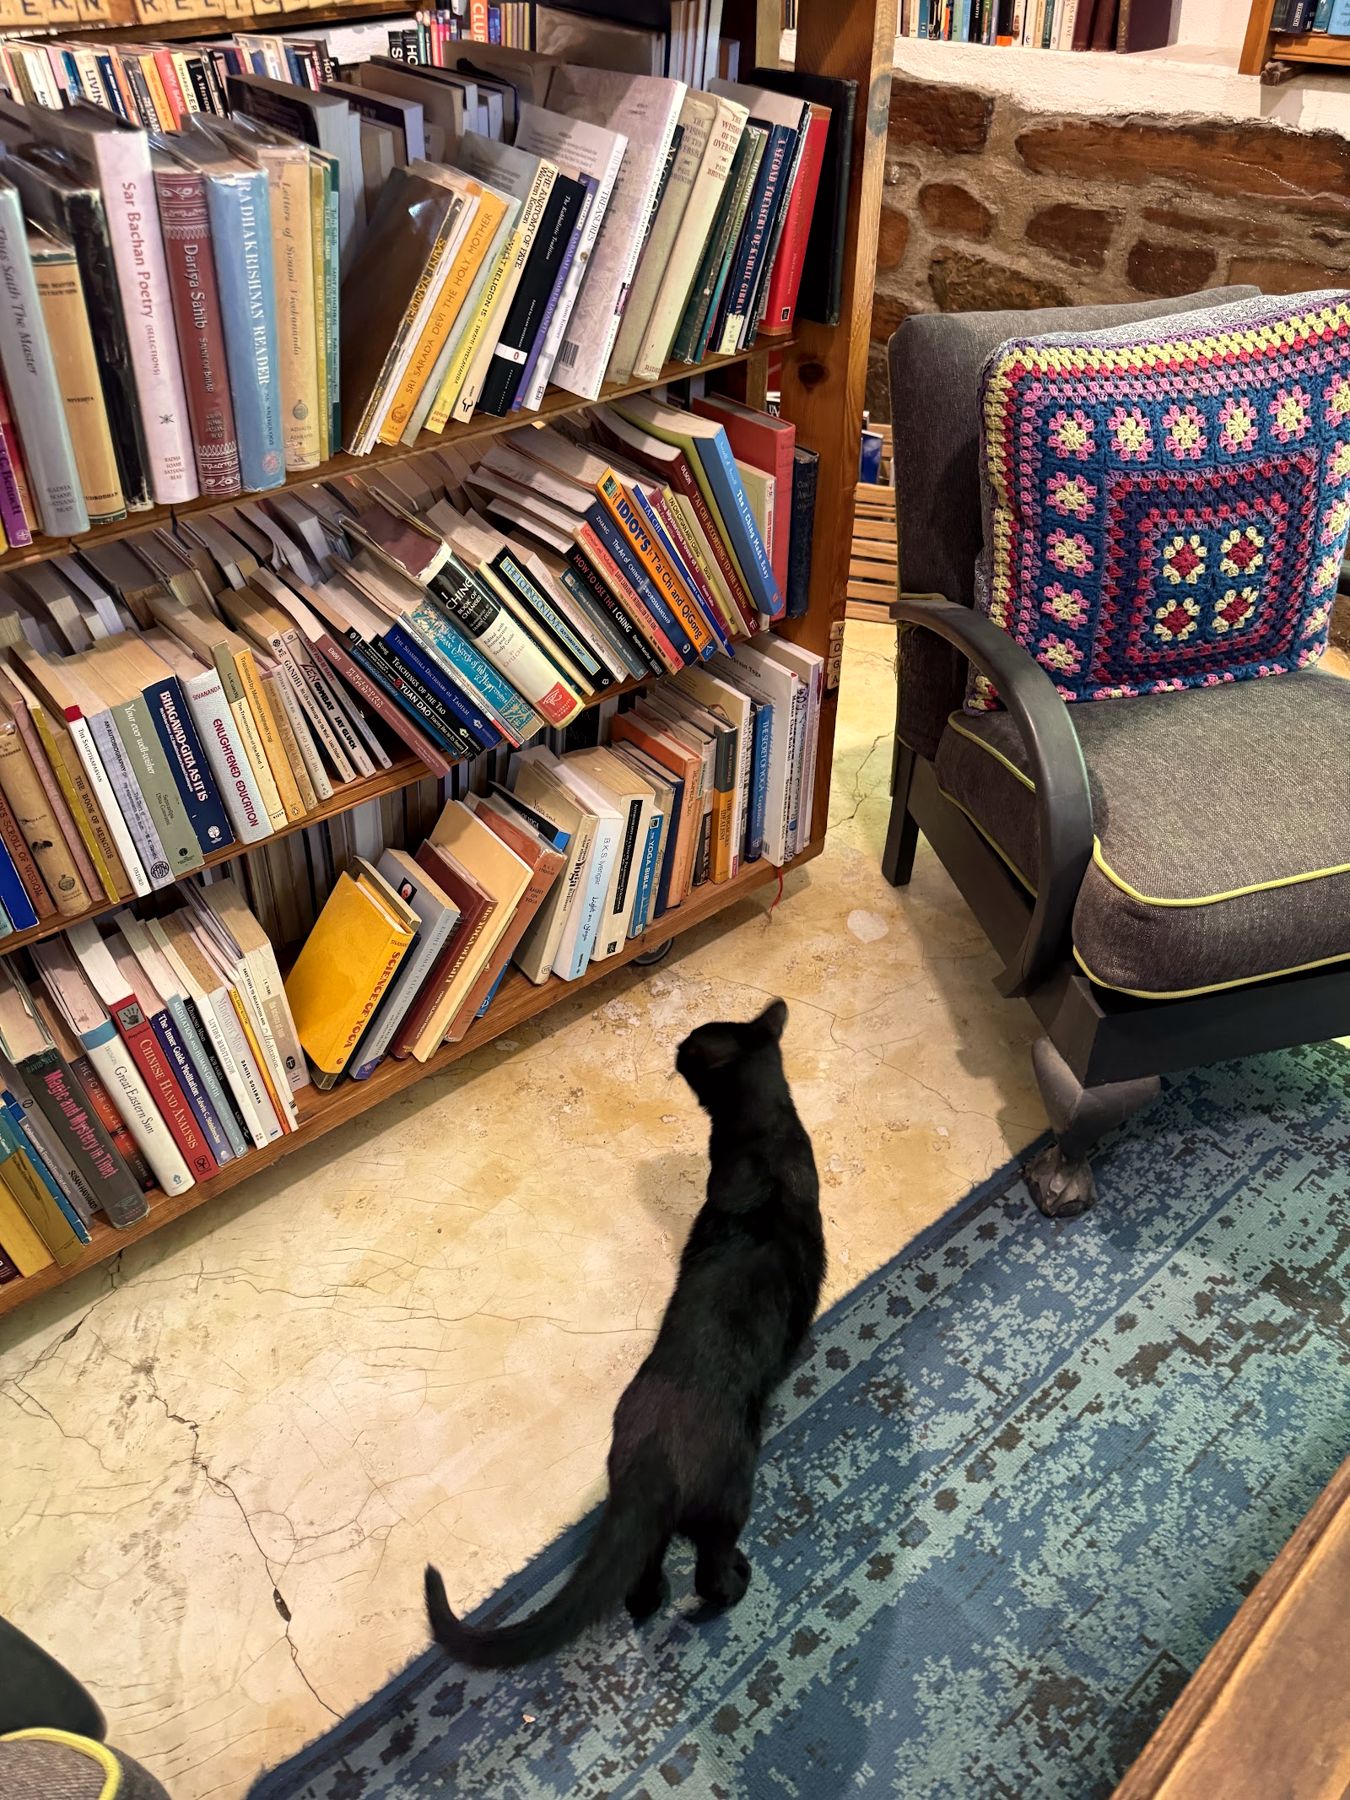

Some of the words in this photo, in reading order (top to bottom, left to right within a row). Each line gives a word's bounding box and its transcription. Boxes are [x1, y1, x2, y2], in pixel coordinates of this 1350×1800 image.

[541, 168, 556, 189] THE
[767, 146, 784, 183] SECOND
[121, 180, 140, 208] Sar
[529, 165, 548, 196] Warren
[280, 182, 294, 223] Letters
[519, 196, 537, 225] Kenton
[525, 188, 549, 235] ANATOMY
[562, 195, 571, 206] The
[754, 185, 774, 231] TREASURY
[283, 227, 295, 239] of
[552, 205, 568, 236] Kabbalistic
[126, 210, 148, 267] Bachan
[497, 237, 515, 266] WHAT
[521, 233, 533, 247] OF
[544, 236, 558, 262] Tradition
[560, 230, 579, 270] QABALAH
[750, 233, 761, 245] OF
[180, 244, 203, 288] Dariya
[285, 246, 298, 283] Swami
[426, 237, 448, 272] SAINT
[512, 246, 528, 271] FATE
[741, 247, 758, 281] KAHLIL
[134, 270, 156, 319] Poetry
[236, 180, 265, 320] RADHAKRISHNAN
[252, 326, 271, 385] READER
[482, 266, 504, 308] RELIGION
[549, 274, 564, 303] AMBER
[189, 291, 209, 330] Sahib
[403, 274, 434, 327] NAMDEV
[404, 377, 418, 394] SRI
[411, 337, 436, 377] SARADA
[429, 310, 448, 336] DEVI
[441, 287, 458, 310] THE
[451, 256, 472, 287] HOLY
[465, 211, 493, 256] MOTHER
[479, 307, 489, 318] IS
[733, 282, 748, 315] GIBRAN
[288, 289, 302, 356] Vivekananda
[538, 303, 555, 334] JAYANTI
[467, 323, 481, 346] SWAMI
[594, 514, 611, 536] ZHANG
[611, 496, 654, 554] IDIOT'S
[734, 489, 748, 509] The
[742, 514, 758, 539] Ching
[751, 539, 765, 560] Made
[758, 561, 771, 580] Easy
[610, 537, 623, 552] The
[617, 548, 629, 560] Art
[622, 556, 632, 565] of
[626, 562, 645, 586] CHINESE
[648, 554, 667, 575] T'ai
[443, 577, 476, 611] CHING
[572, 553, 591, 574] HOW
[585, 571, 599, 585] TO
[592, 580, 607, 597] USE
[601, 593, 616, 609] THE
[613, 610, 634, 634] CHING
[658, 571, 676, 592] Chi
[455, 598, 472, 616] BOOK
[467, 588, 479, 600] OF
[459, 594, 484, 620] CHANGES
[640, 583, 672, 626] SWORDSMANSHIP
[669, 588, 685, 607] and
[676, 603, 706, 640] QiGong
[282, 657, 305, 688] GANDHI
[390, 655, 421, 688] TEACHINGS
[417, 684, 428, 696] OF
[424, 692, 438, 706] THE
[433, 700, 448, 716] TAO
[393, 634, 405, 647] THE
[402, 643, 428, 670] SHAMBHALA
[423, 667, 448, 693] DICTIONARY
[445, 689, 453, 698] OF
[450, 694, 471, 716] TAOISM
[191, 684, 222, 701] SIVANANDA
[299, 687, 307, 695] His
[299, 658, 323, 686] ZEN
[312, 680, 335, 712] COMBAT
[333, 715, 345, 729] JAY
[339, 726, 358, 751] GLUCK
[302, 693, 311, 702] Life
[306, 699, 314, 707] and
[102, 719, 111, 729] AN
[308, 705, 321, 721] Message
[315, 717, 324, 726] for
[741, 717, 750, 736] YOGA
[761, 719, 769, 734] THE
[158, 690, 197, 769] BHAGAVAD-GITA
[321, 728, 332, 740] World
[740, 736, 749, 750] FOR
[106, 728, 127, 773] AUTOBIOGRAPHY
[759, 733, 769, 760] SECRET
[187, 766, 201, 782] AS
[210, 717, 243, 779] ENLIGHTENED
[233, 778, 260, 828] EDUCATION
[737, 751, 748, 789] PREGNANCY
[759, 759, 767, 770] OF
[73, 775, 86, 792] THE
[192, 779, 205, 792] IT
[757, 769, 766, 792] YOGA
[81, 793, 96, 815] BOOK
[196, 789, 209, 802] IS
[90, 814, 100, 826] OF
[718, 808, 728, 841] IDEALISM
[94, 825, 115, 861] MENCIUS
[644, 839, 656, 867] YOGA
[565, 855, 586, 889] Yoga
[640, 866, 651, 890] BIBLE
[586, 895, 599, 914] Light
[586, 913, 592, 922] on
[430, 924, 447, 948] EIGHT
[579, 922, 591, 942] Yoga
[417, 947, 435, 975] HUMAN
[367, 949, 402, 1003] SCIENCE
[400, 974, 420, 1005] TALENTS
[359, 999, 374, 1018] OF
[206, 1016, 222, 1040] LIVING
[214, 1038, 236, 1076] MEDITATION
[342, 1016, 366, 1052] YOGA
[171, 1000, 196, 1040] MEDITATION
[188, 1039, 199, 1052] AND
[194, 1048, 211, 1073] HUMAN
[203, 1070, 222, 1098] GROWTH
[40, 1067, 73, 1103] Magic
[137, 1036, 169, 1081] CHINESE
[157, 1078, 182, 1109] HAND
[171, 1105, 202, 1150] ANALYSIS
[156, 1013, 170, 1029] The
[163, 1027, 178, 1047] Inner
[171, 1044, 187, 1065] Guide
[179, 1063, 202, 1097] Meditation
[194, 1095, 209, 1114] Edwin
[204, 1116, 223, 1145] Steinbrecher
[239, 1058, 253, 1080] DANIEL
[247, 1078, 263, 1105] GOLEMAN
[58, 1094, 83, 1118] and
[112, 1063, 135, 1091] Great
[124, 1086, 150, 1120] Eastern
[140, 1114, 159, 1135] Sun
[66, 1111, 102, 1154] Mystery
[88, 1144, 107, 1160] in
[93, 1152, 119, 1180] Tibet
